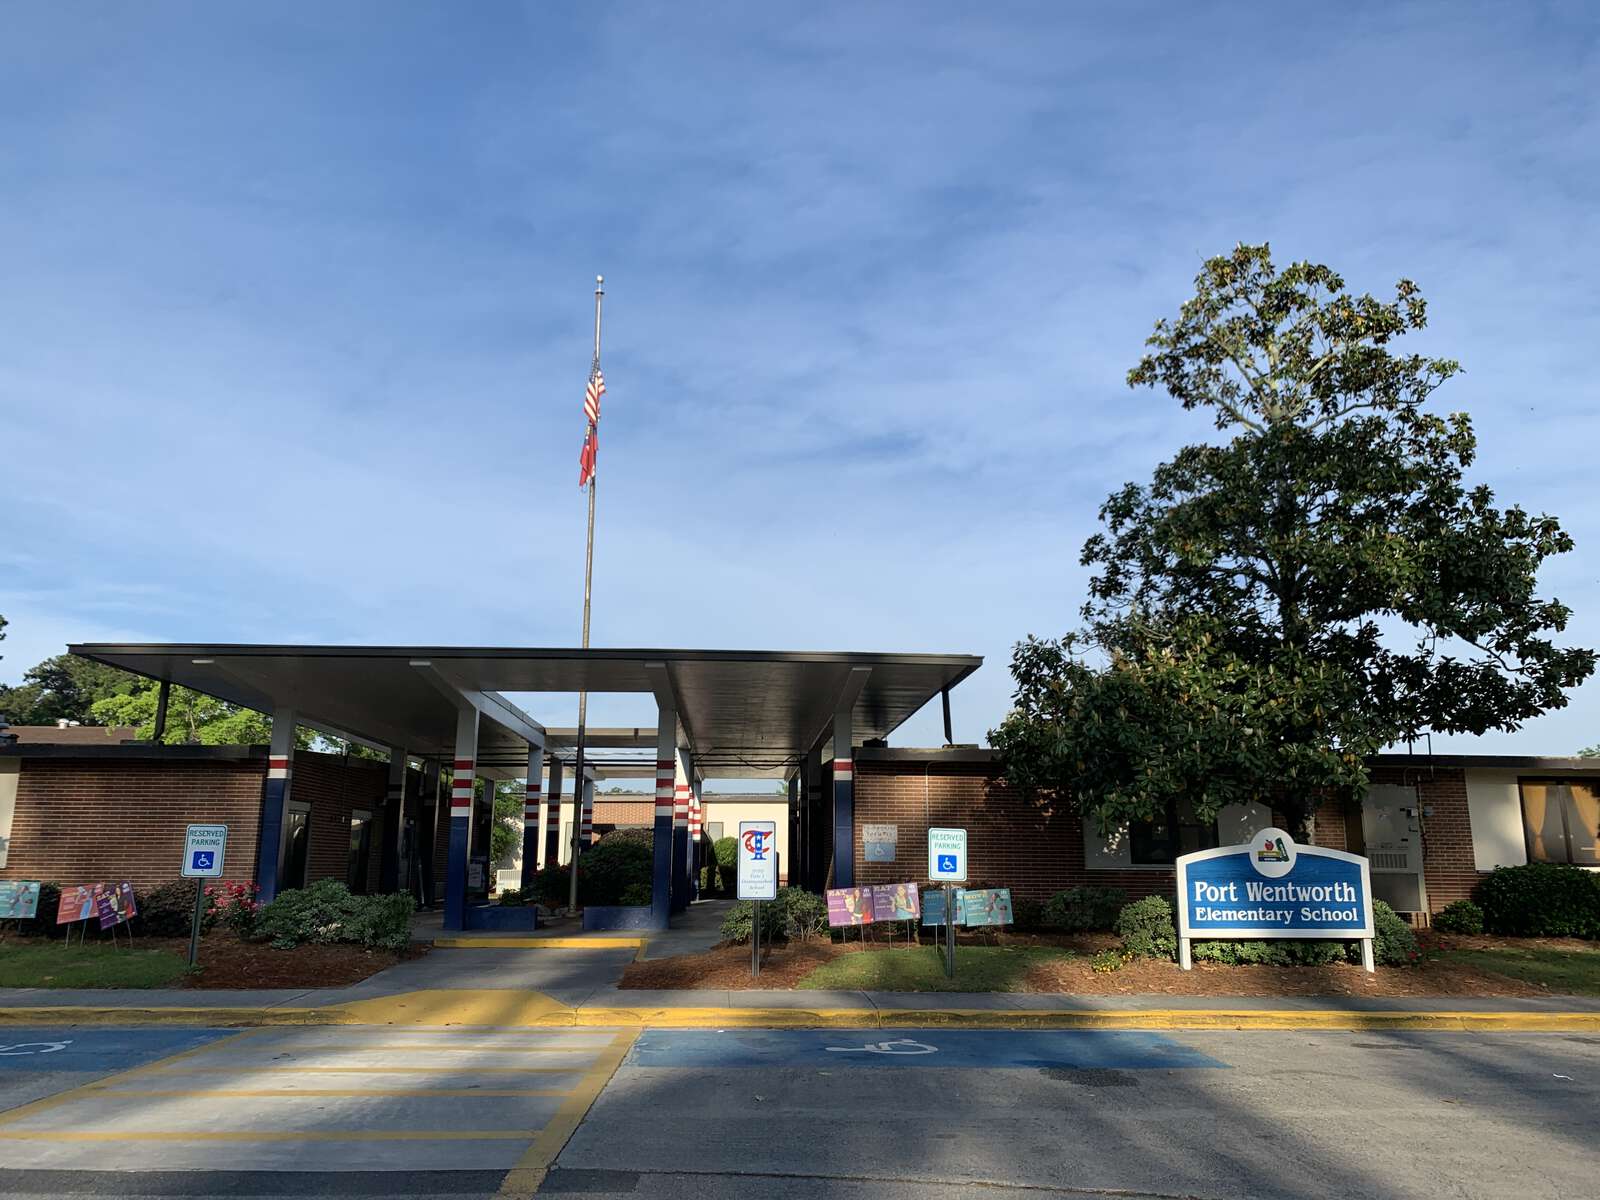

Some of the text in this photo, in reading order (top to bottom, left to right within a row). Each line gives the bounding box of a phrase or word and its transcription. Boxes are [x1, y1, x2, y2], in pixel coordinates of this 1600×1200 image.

[191, 838, 221, 846] PARKING
[931, 833, 964, 841] RESERVED
[1194, 881, 1357, 903] Port Wentworth
[1195, 907, 1358, 925] Elementary School
